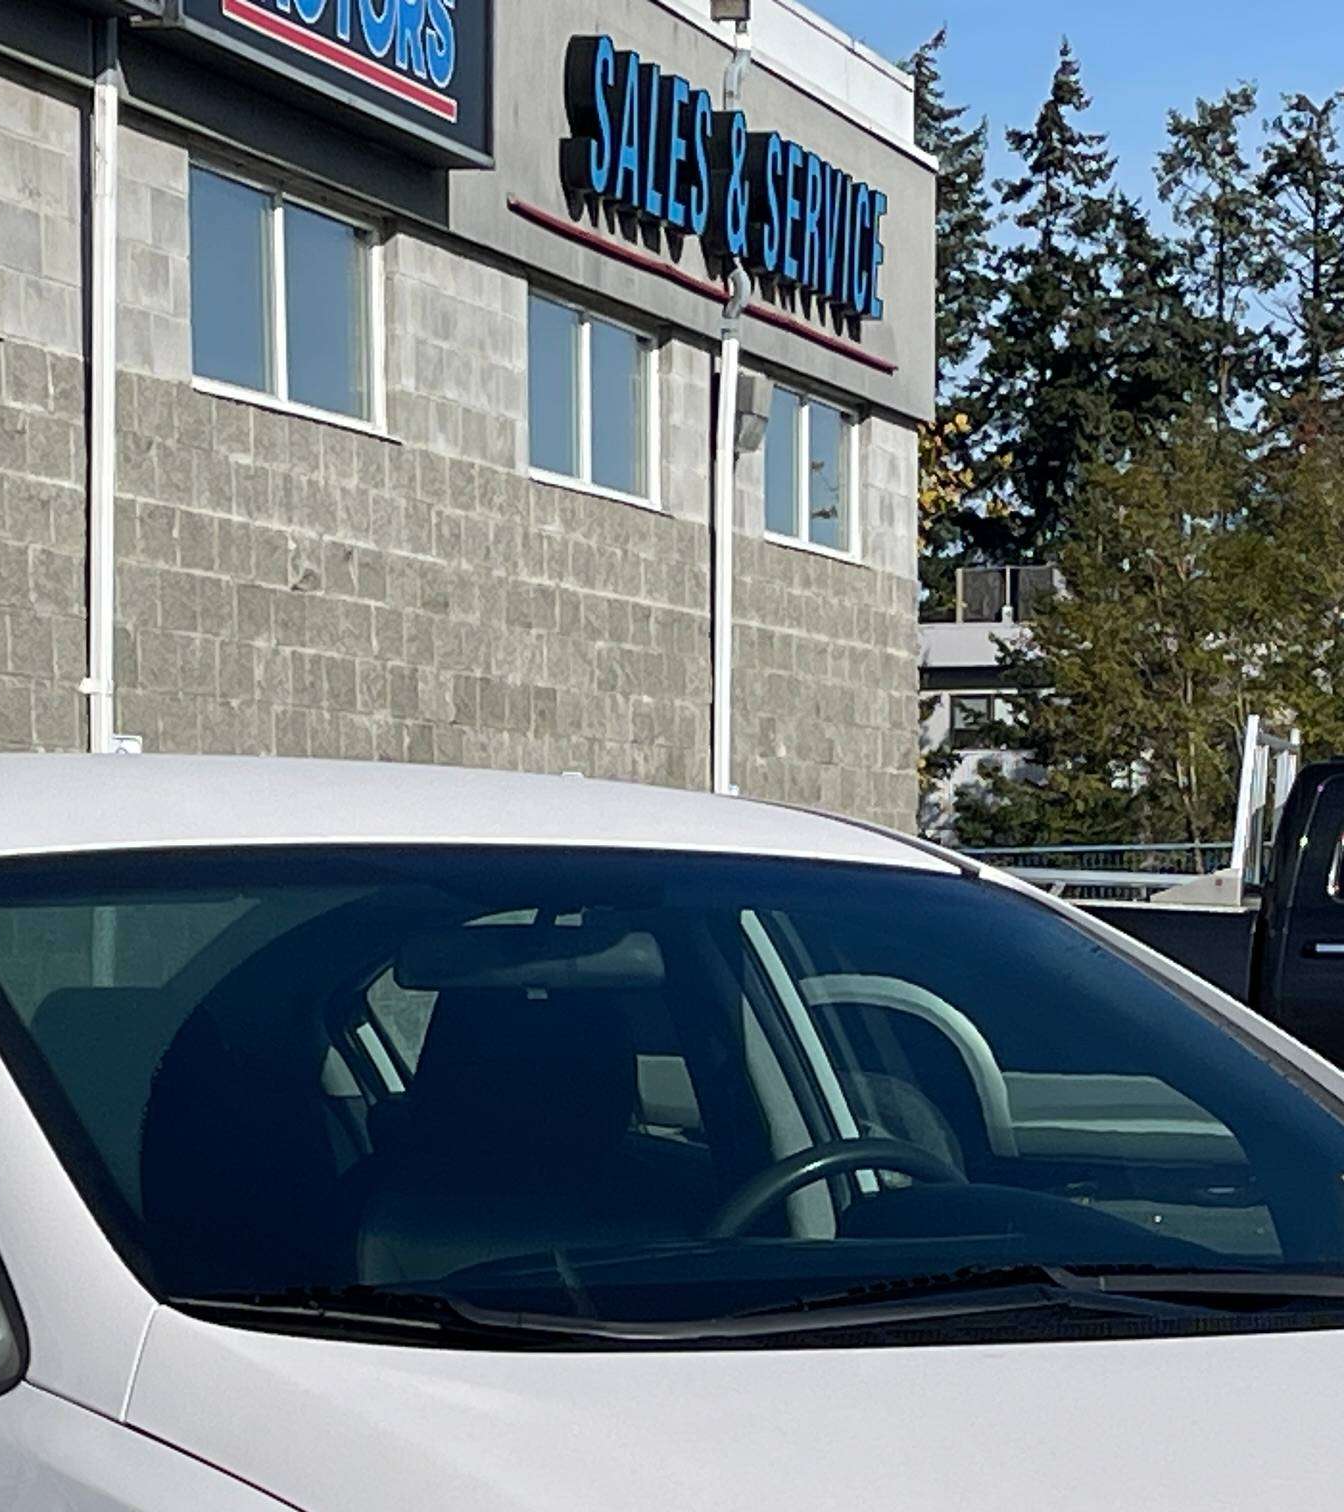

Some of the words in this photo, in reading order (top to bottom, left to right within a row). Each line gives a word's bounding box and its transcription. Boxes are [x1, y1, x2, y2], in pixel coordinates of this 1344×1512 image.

[587, 35, 714, 236] SALES
[723, 110, 749, 257] &
[763, 130, 887, 321] SERVICE
